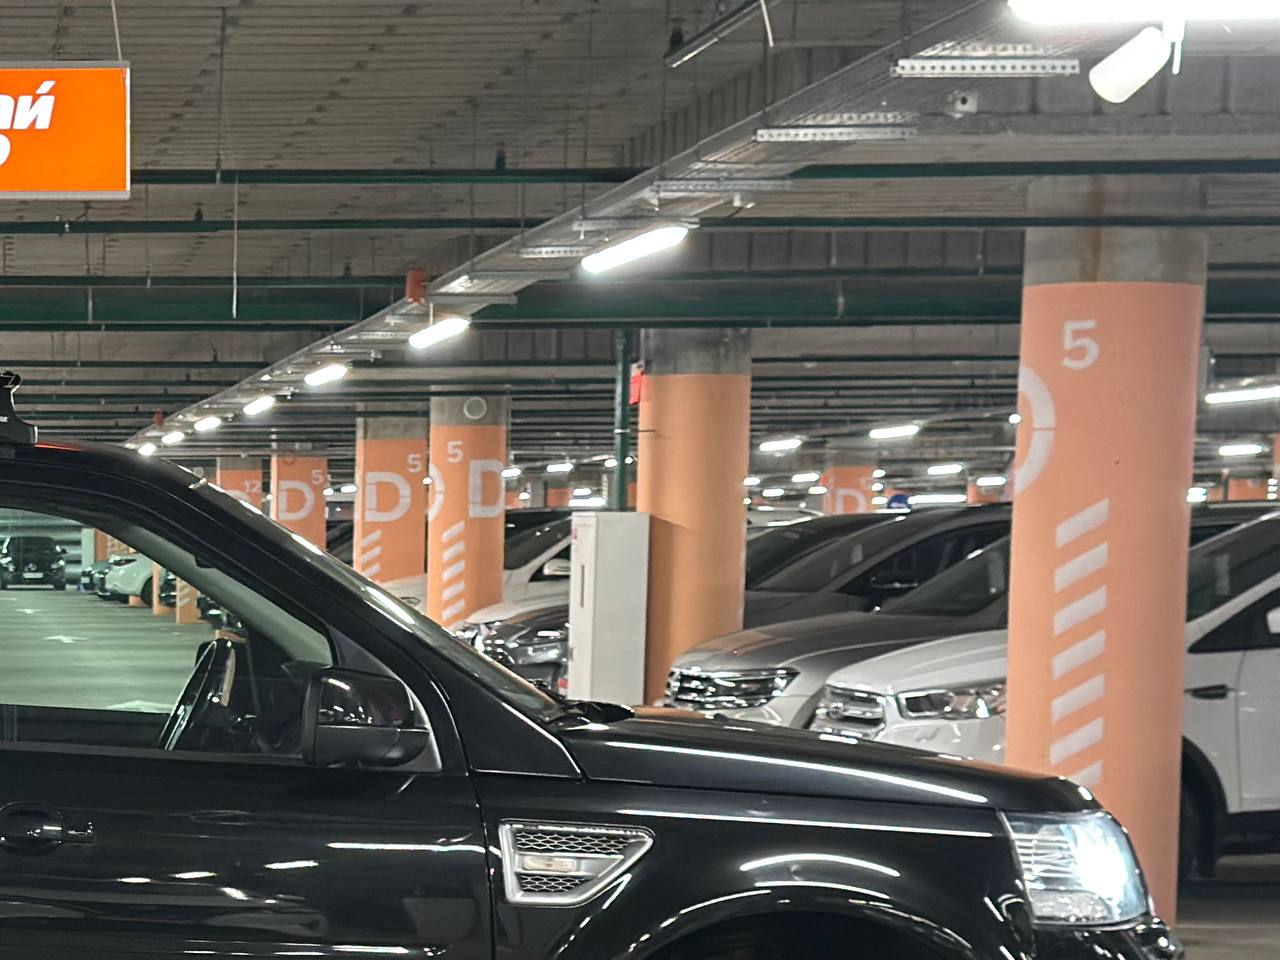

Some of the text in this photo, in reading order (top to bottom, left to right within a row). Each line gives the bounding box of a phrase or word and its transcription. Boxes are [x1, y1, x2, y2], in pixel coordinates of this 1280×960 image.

[1061, 319, 1100, 370] 5
[407, 453, 422, 473] 5
[447, 441, 464, 463] 5
[244, 480, 261, 493] 12
[311, 469, 324, 485] 5
[468, 459, 505, 518] D
[278, 480, 315, 521] D
[364, 471, 411, 522] D
